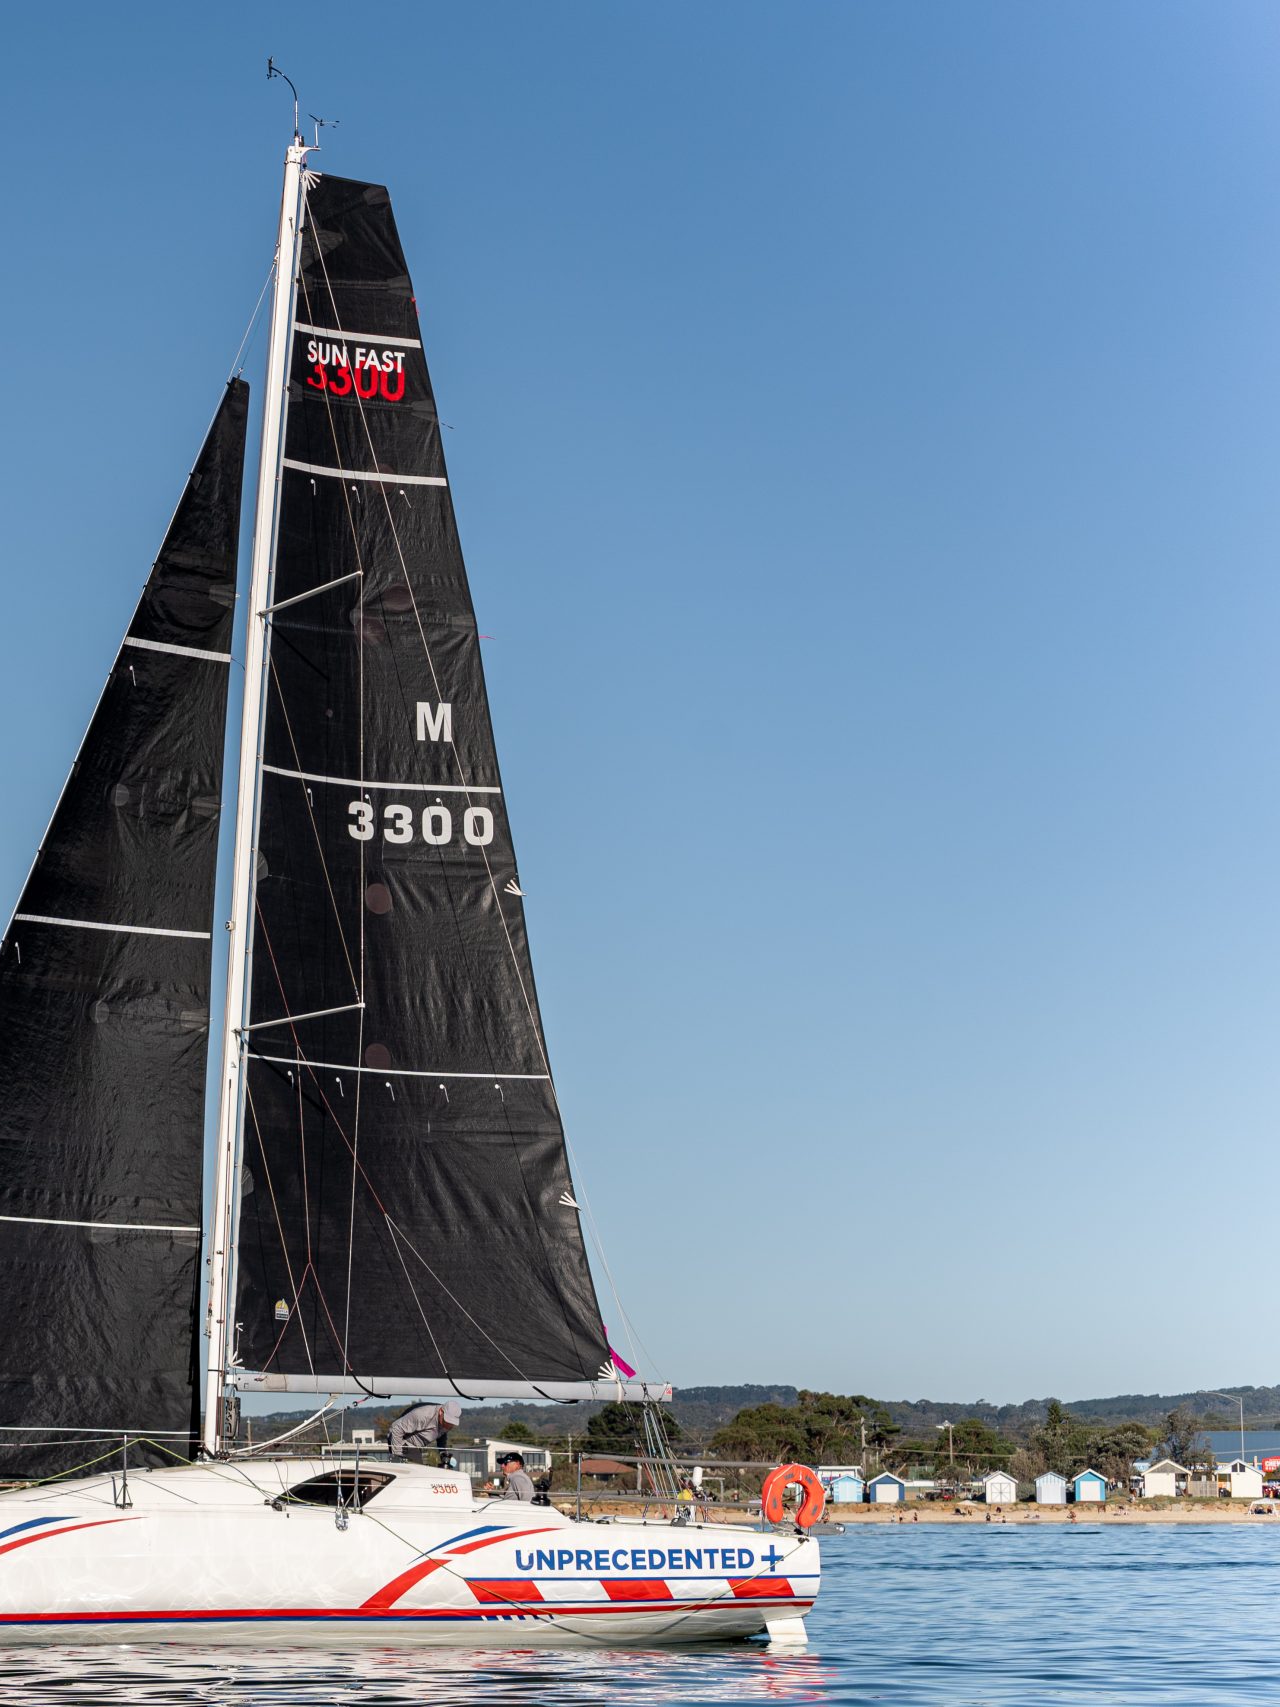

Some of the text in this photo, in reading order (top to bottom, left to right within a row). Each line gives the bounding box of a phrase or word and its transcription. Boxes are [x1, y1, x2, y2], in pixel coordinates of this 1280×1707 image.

[307, 340, 406, 374] SUN FAST
[307, 357, 406, 402] 3300
[416, 701, 453, 743] M
[348, 801, 494, 846] 3300
[514, 1548, 755, 1572] UNPRECEDENTED
